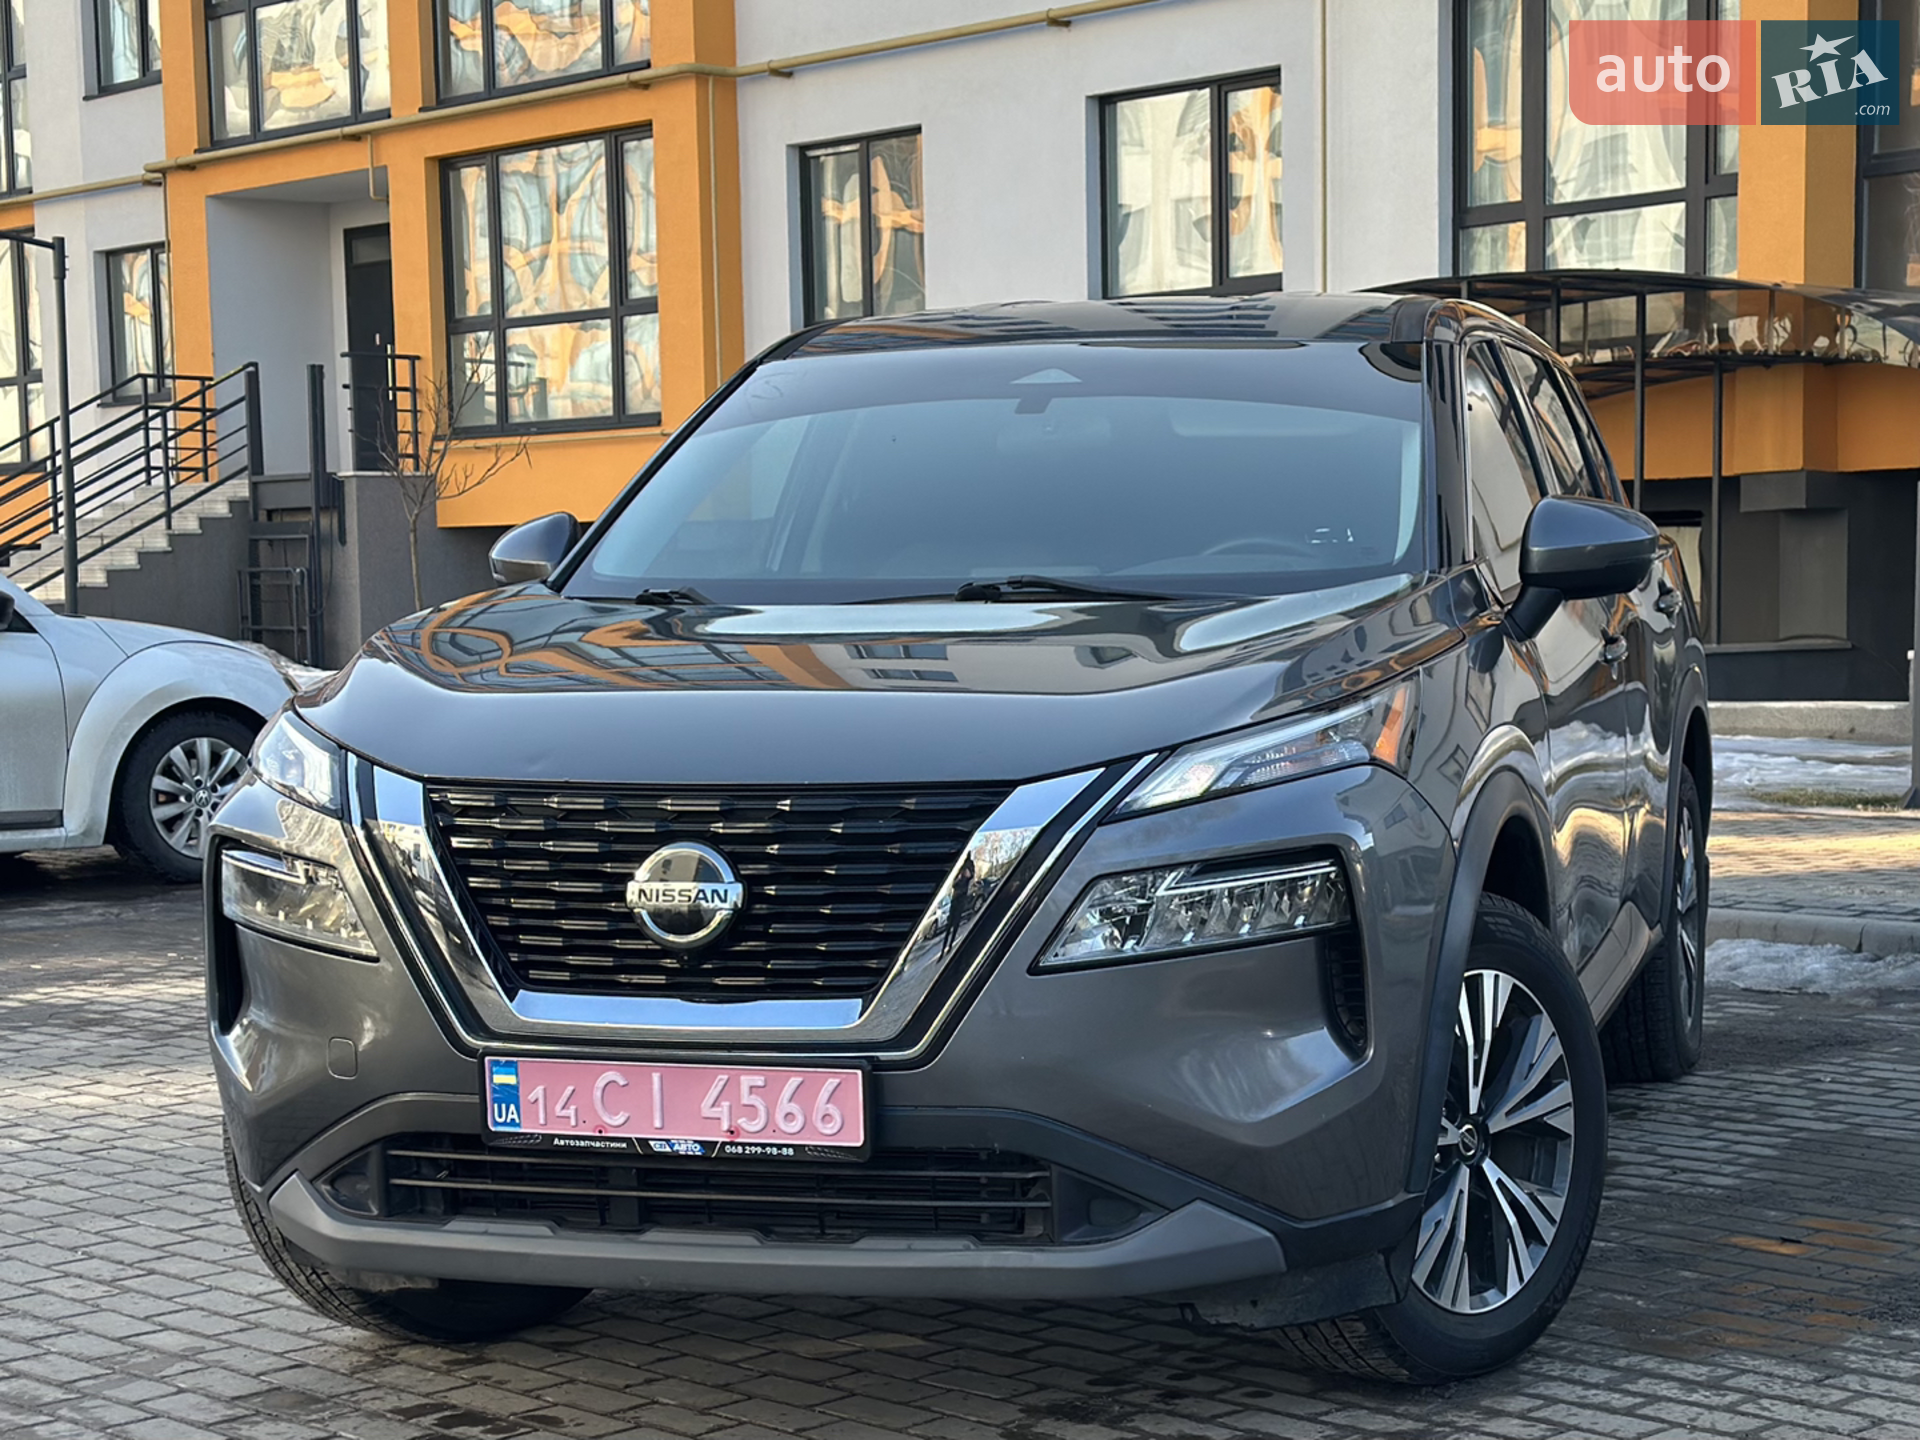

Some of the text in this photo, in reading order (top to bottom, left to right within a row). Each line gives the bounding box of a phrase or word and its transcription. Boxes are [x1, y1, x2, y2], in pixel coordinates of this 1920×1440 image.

[638, 888, 728, 903] NISSAN
[494, 1103, 520, 1123] UA
[527, 1085, 578, 1128] 14
[701, 1075, 844, 1136] 4566
[553, 1137, 628, 1149] Автозапчастини
[725, 1144, 794, 1156] 068 299-98-88
